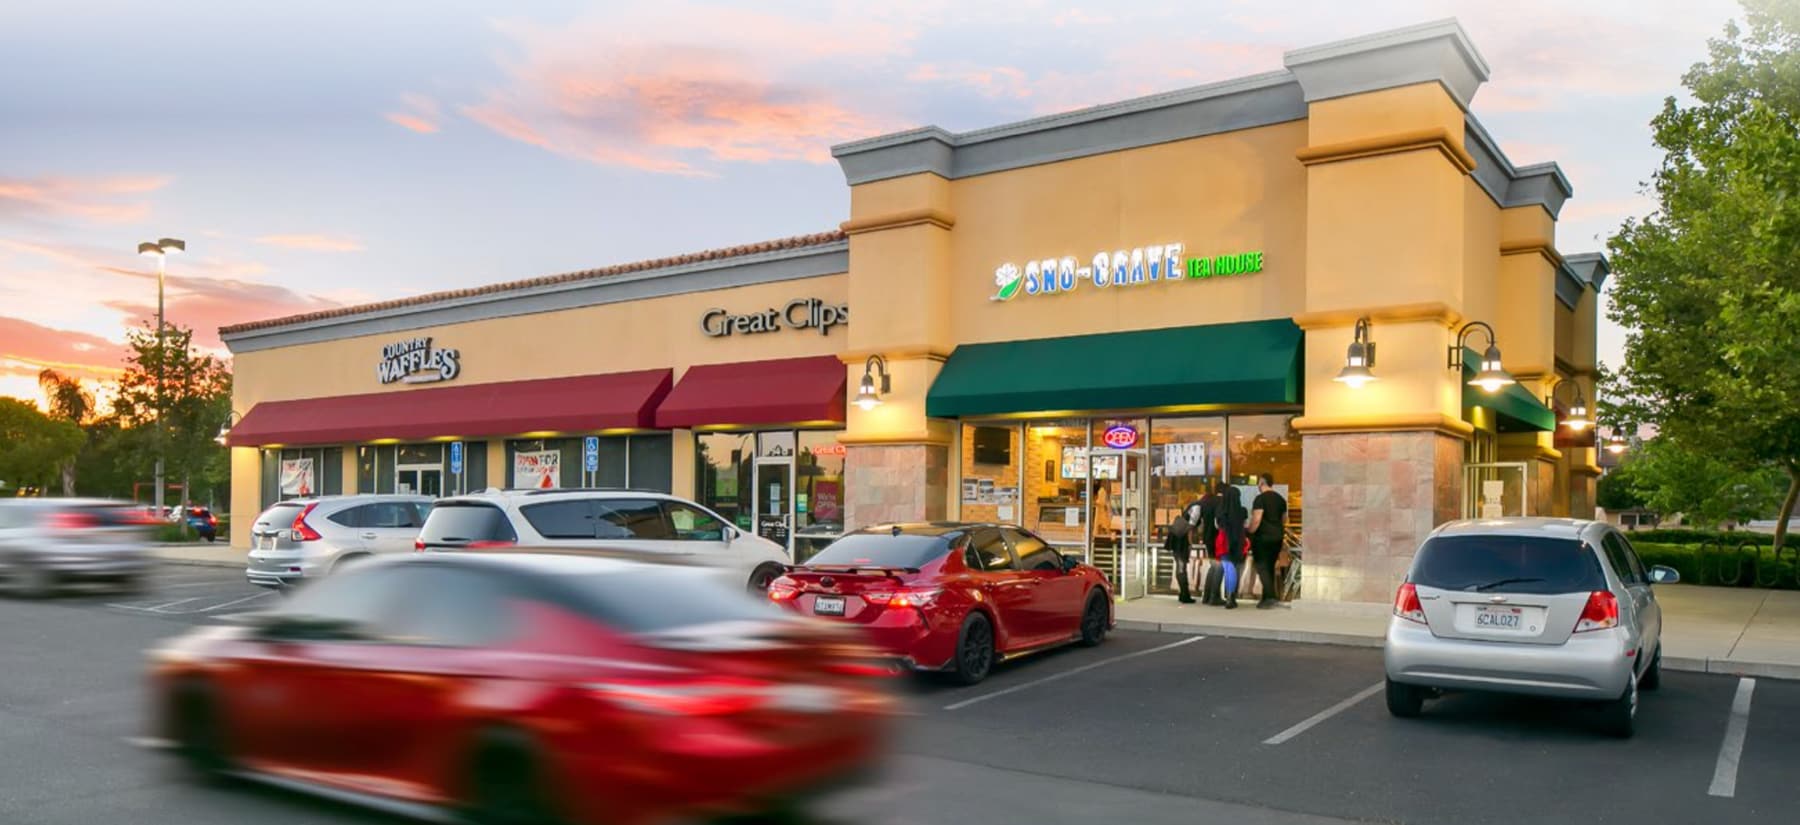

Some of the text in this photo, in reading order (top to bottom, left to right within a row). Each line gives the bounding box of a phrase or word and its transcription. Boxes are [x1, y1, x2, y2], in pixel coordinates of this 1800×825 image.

[1025, 243, 1262, 295] SNO-CRAVE TEA HOUSE
[701, 298, 848, 337] Great Clips
[383, 337, 428, 361] COUNTRY
[377, 348, 460, 384] WAFFLES
[1104, 431, 1136, 444] OPEN
[539, 453, 558, 466] FOR
[1477, 614, 1519, 627] 6CAL027
